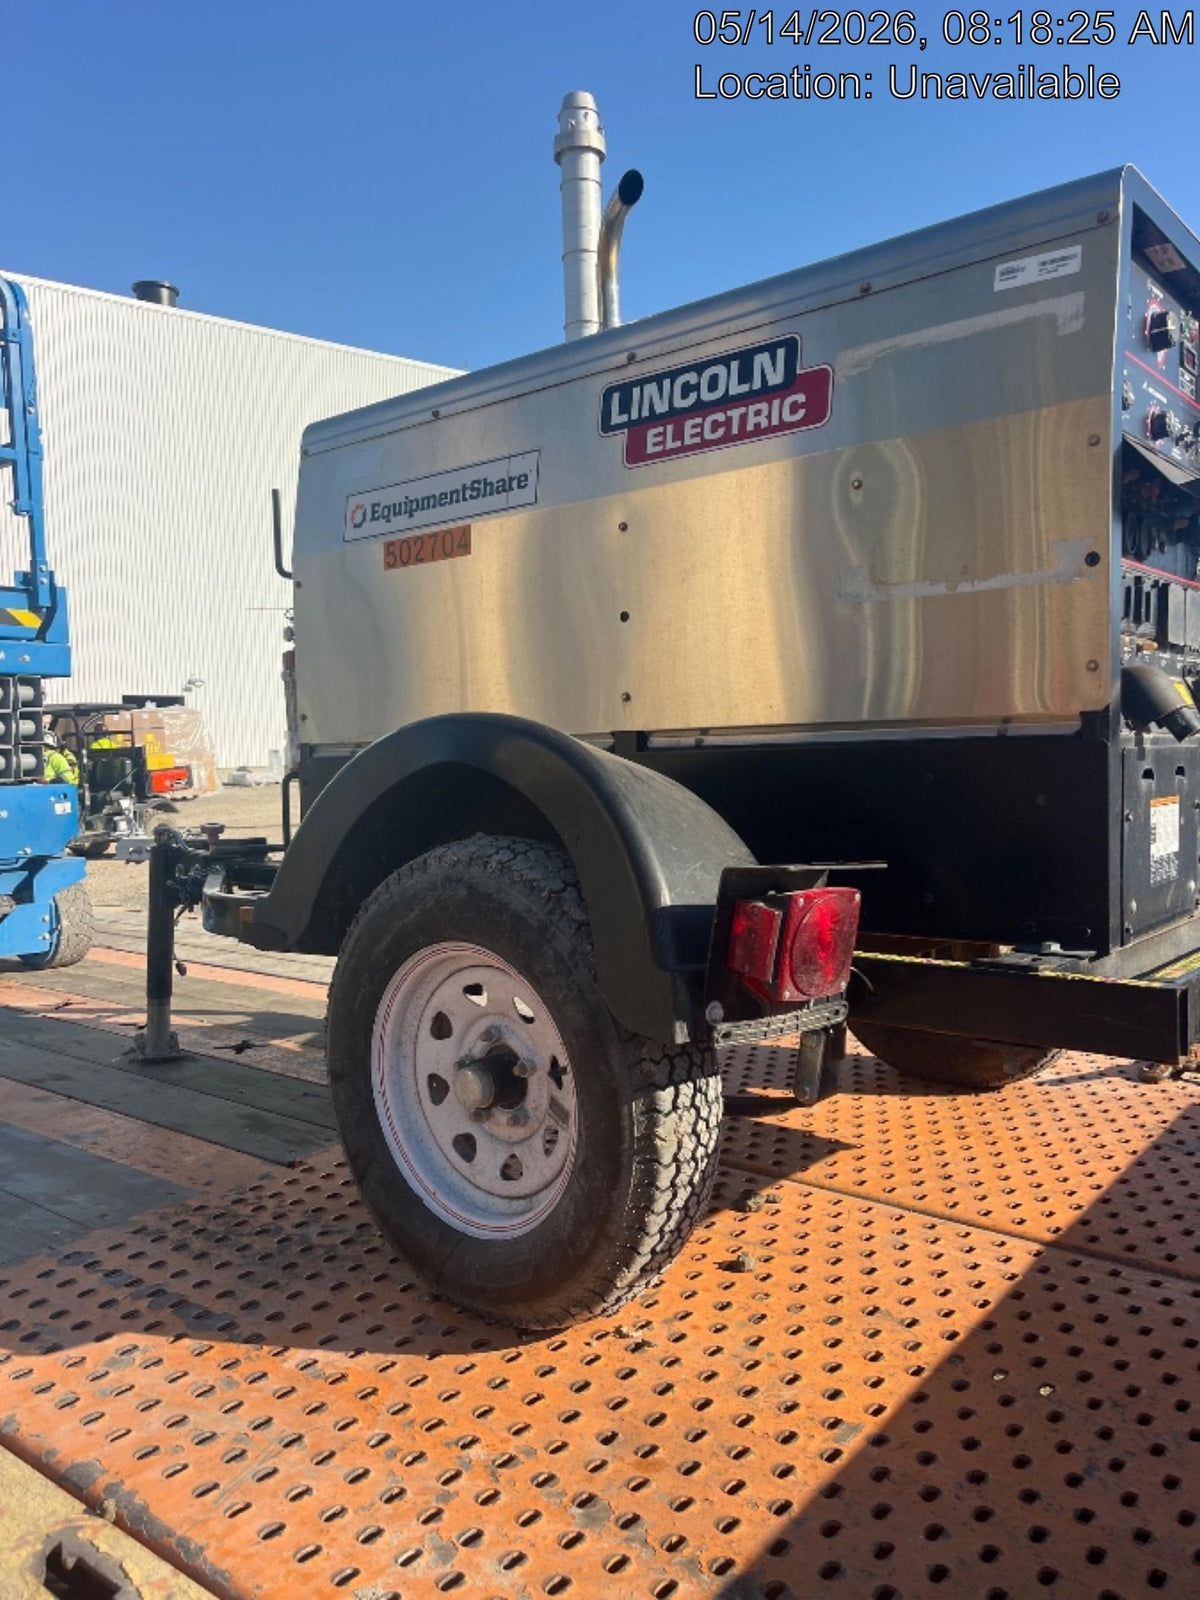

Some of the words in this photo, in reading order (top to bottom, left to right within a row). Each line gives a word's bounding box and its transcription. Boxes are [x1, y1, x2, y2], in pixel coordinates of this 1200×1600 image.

[610, 347, 786, 426] LINCOLN
[646, 392, 806, 455] ELECTRIC
[369, 472, 529, 524] EquipmentShare
[386, 531, 470, 569] 502704
